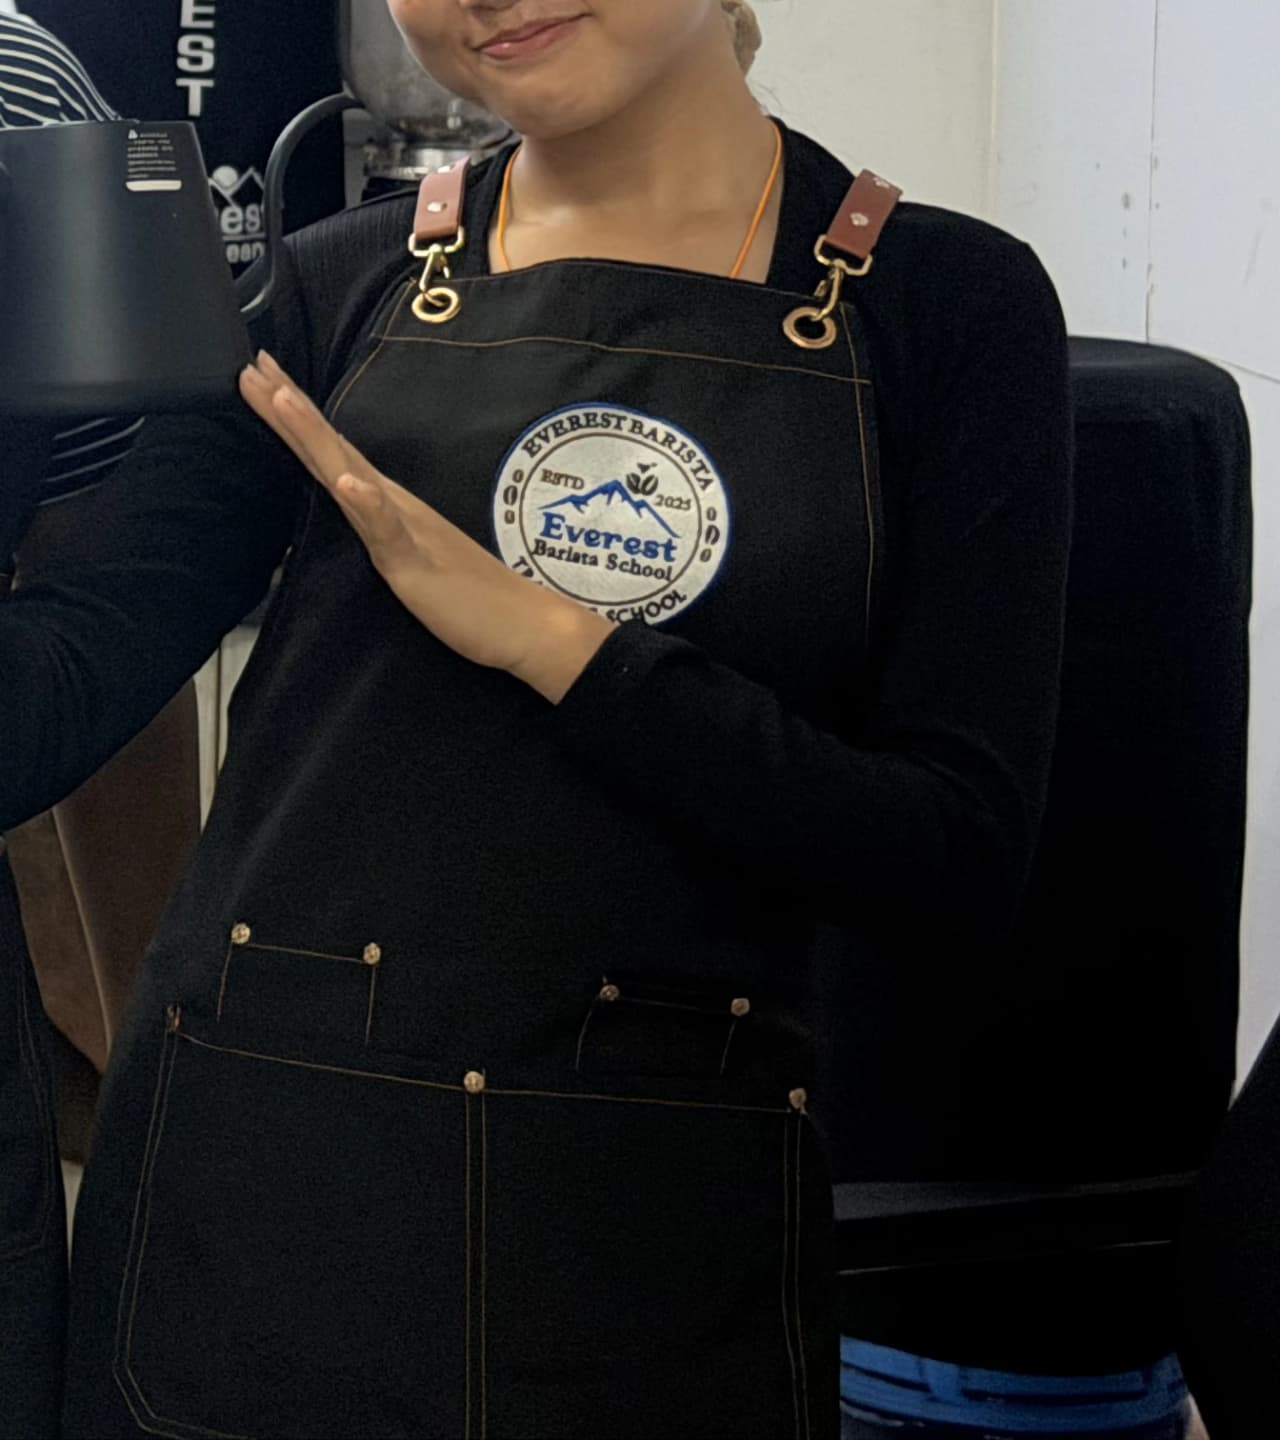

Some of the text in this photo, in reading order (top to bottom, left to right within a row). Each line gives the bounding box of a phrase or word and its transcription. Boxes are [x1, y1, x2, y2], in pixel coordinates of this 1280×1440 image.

[522, 412, 714, 492] EVEREST BARISTA
[541, 468, 585, 491] ESTD
[532, 538, 673, 581] Barista School
[540, 511, 678, 562] Everest
